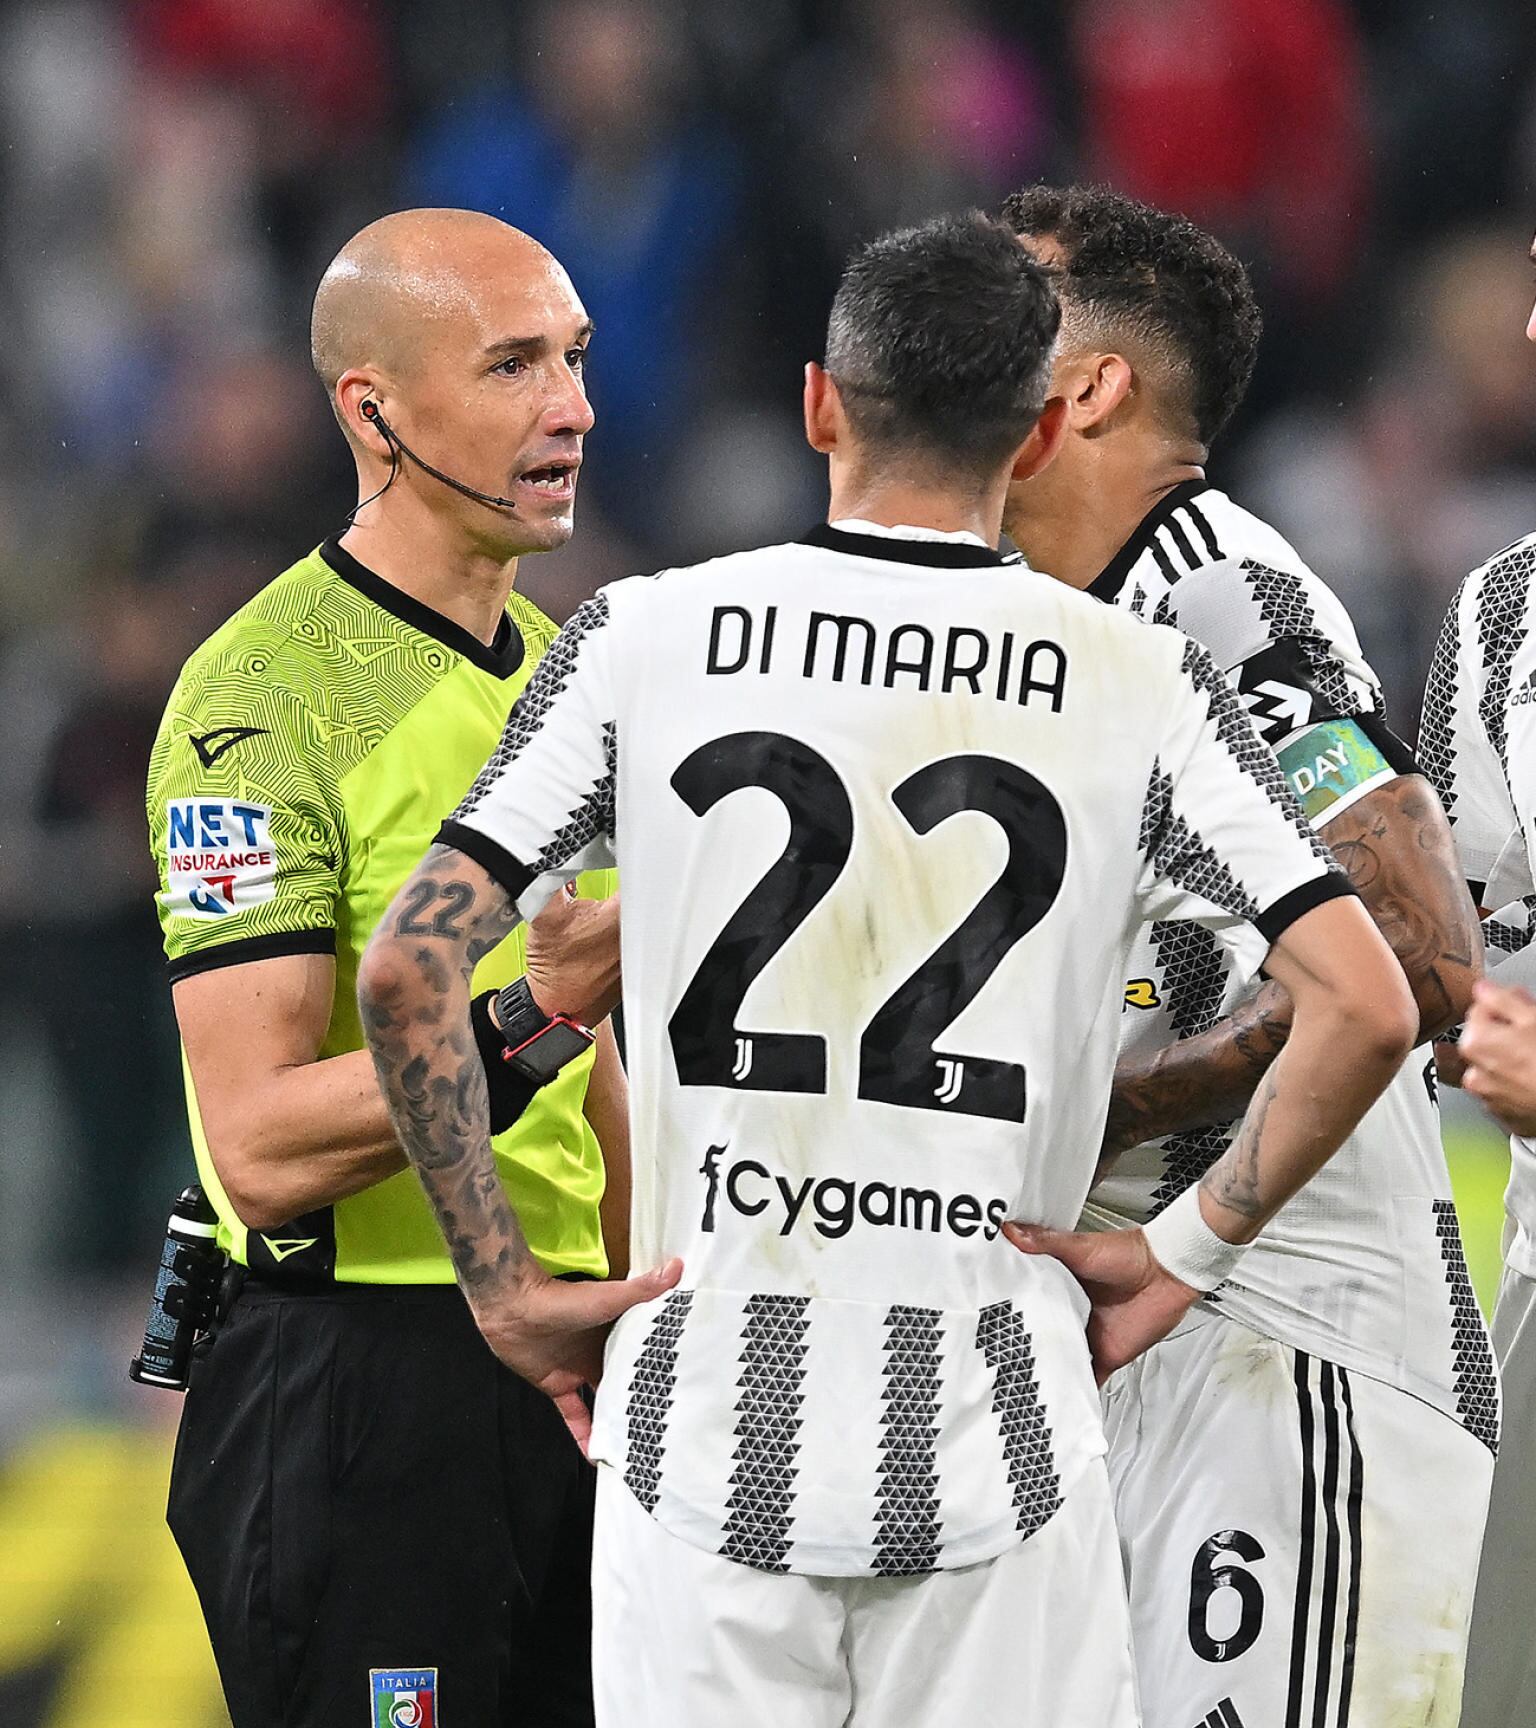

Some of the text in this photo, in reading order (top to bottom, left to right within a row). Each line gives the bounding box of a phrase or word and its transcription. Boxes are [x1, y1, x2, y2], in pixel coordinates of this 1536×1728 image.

[706, 605, 1069, 713] DI MARIA
[1292, 741, 1350, 795] DAY
[169, 804, 265, 849] NET
[170, 851, 272, 872] INSURANCE
[394, 878, 477, 940] 22
[667, 730, 1068, 1124] 22
[726, 1159, 1007, 1241] Cygames
[1187, 1529, 1266, 1663] 6
[381, 1677, 427, 1689] ITALIA
